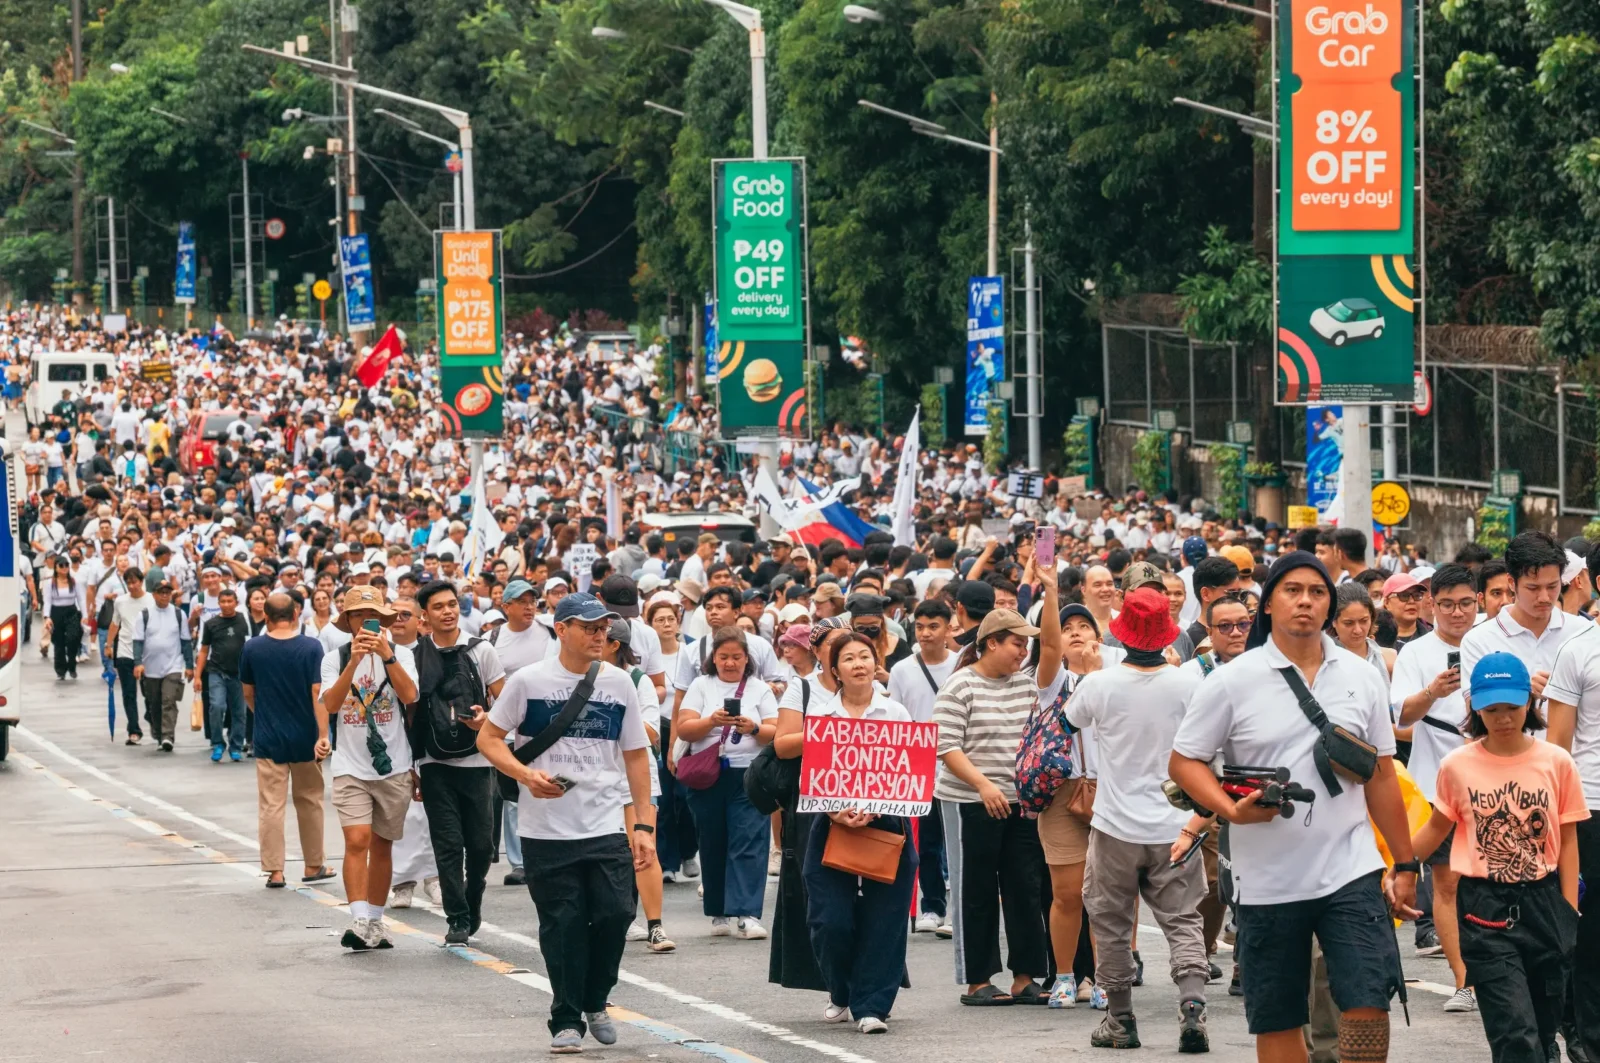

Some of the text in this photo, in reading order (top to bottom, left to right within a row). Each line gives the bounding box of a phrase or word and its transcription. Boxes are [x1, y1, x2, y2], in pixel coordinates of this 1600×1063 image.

[1305, 4, 1388, 35] Grab
[1318, 39, 1375, 67] Car
[1316, 110, 1377, 144] 8%
[1306, 150, 1387, 184] OFF
[732, 174, 785, 196] Grab
[733, 197, 784, 217] Food
[1300, 188, 1393, 208] every day!
[734, 266, 785, 289] OFF
[737, 292, 783, 305] delivery
[731, 305, 790, 317] every day!
[451, 320, 488, 338] OFF
[806, 718, 936, 748] KABABAIHAN
[549, 753, 572, 763] NORTH
[831, 744, 911, 773] KONTRA
[808, 768, 926, 800] KORAPSYON
[1467, 780, 1549, 811] MEOWKIBAKA
[801, 799, 929, 816] UP SIGMA ALPHA NU
